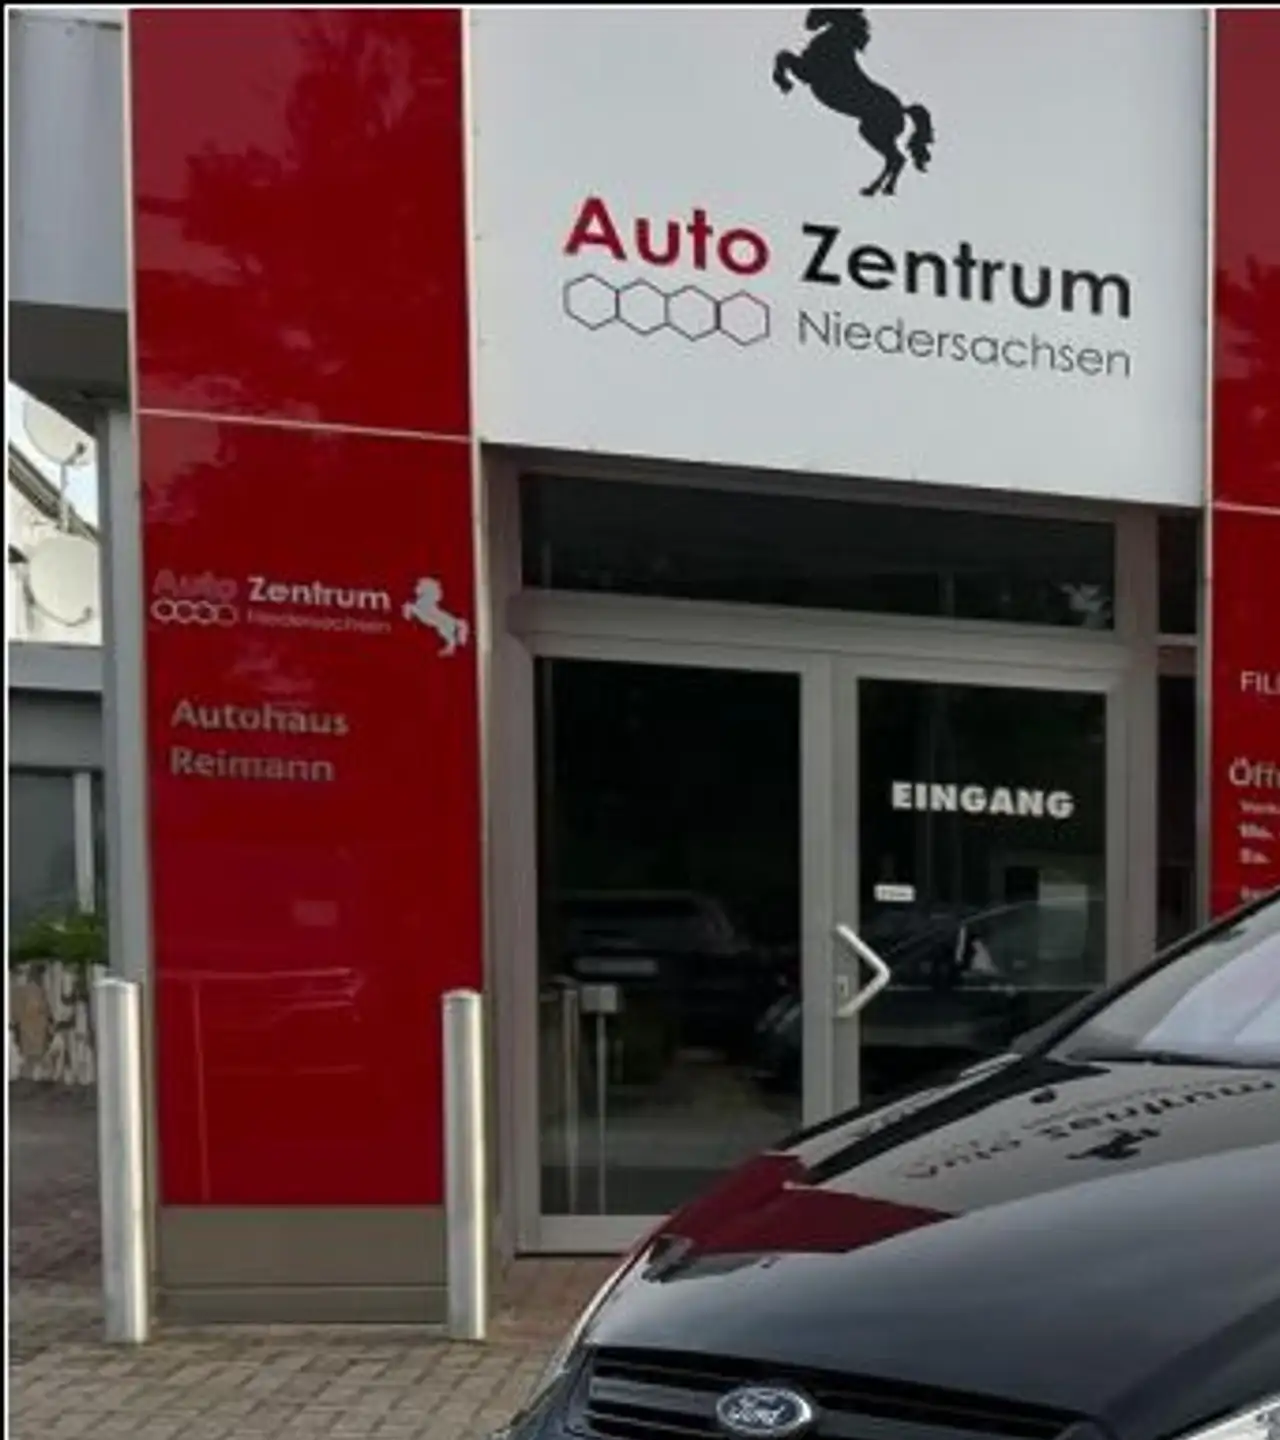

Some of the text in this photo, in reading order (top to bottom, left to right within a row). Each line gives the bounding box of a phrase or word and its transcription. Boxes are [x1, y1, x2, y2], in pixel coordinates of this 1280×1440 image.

[564, 196, 1132, 319] Auto Zentrum
[798, 311, 1132, 378] Niedersachsen
[152, 569, 392, 611] Auto Zentrum
[171, 699, 350, 736] Autohaus
[170, 746, 334, 782] Reimann
[891, 781, 1077, 818] EINGANG
